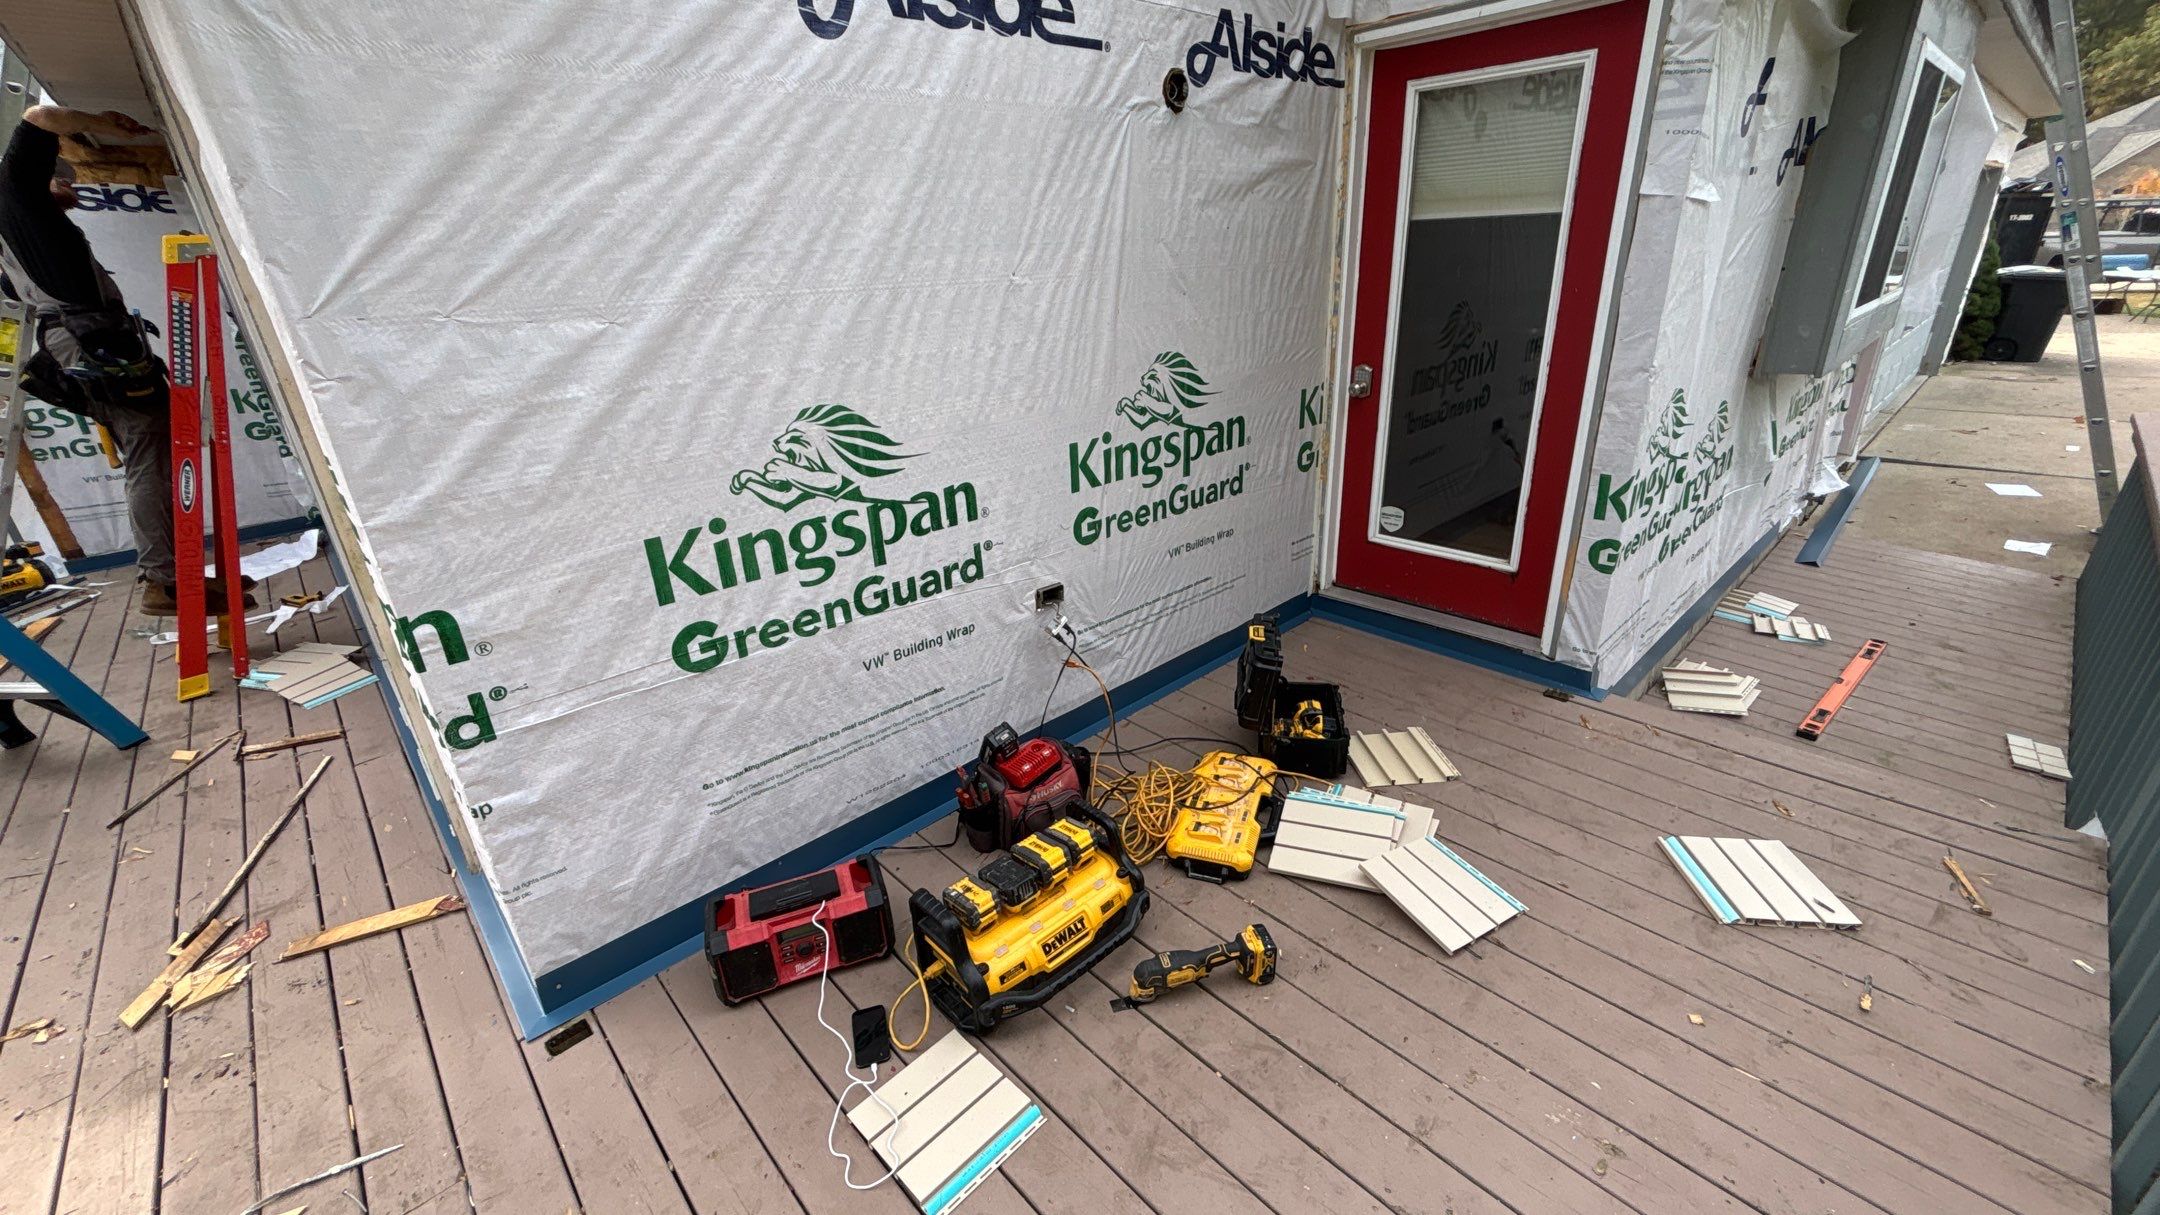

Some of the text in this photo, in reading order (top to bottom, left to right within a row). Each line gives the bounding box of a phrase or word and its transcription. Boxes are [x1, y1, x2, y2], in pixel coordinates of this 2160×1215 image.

[1186, 8, 1345, 88] Alside
[73, 183, 177, 214] side
[184, 468, 192, 502] WERNER
[1185, 534, 1215, 553] Building
[1216, 527, 1234, 541] Wrap
[893, 636, 943, 661] Building
[946, 623, 976, 643] Wrap
[701, 781, 714, 790] Go
[818, 734, 828, 742] for
[828, 729, 840, 737] the
[840, 722, 857, 732] most
[857, 713, 879, 725] current
[879, 699, 913, 716] compliance
[1037, 781, 1063, 799] HUSKY
